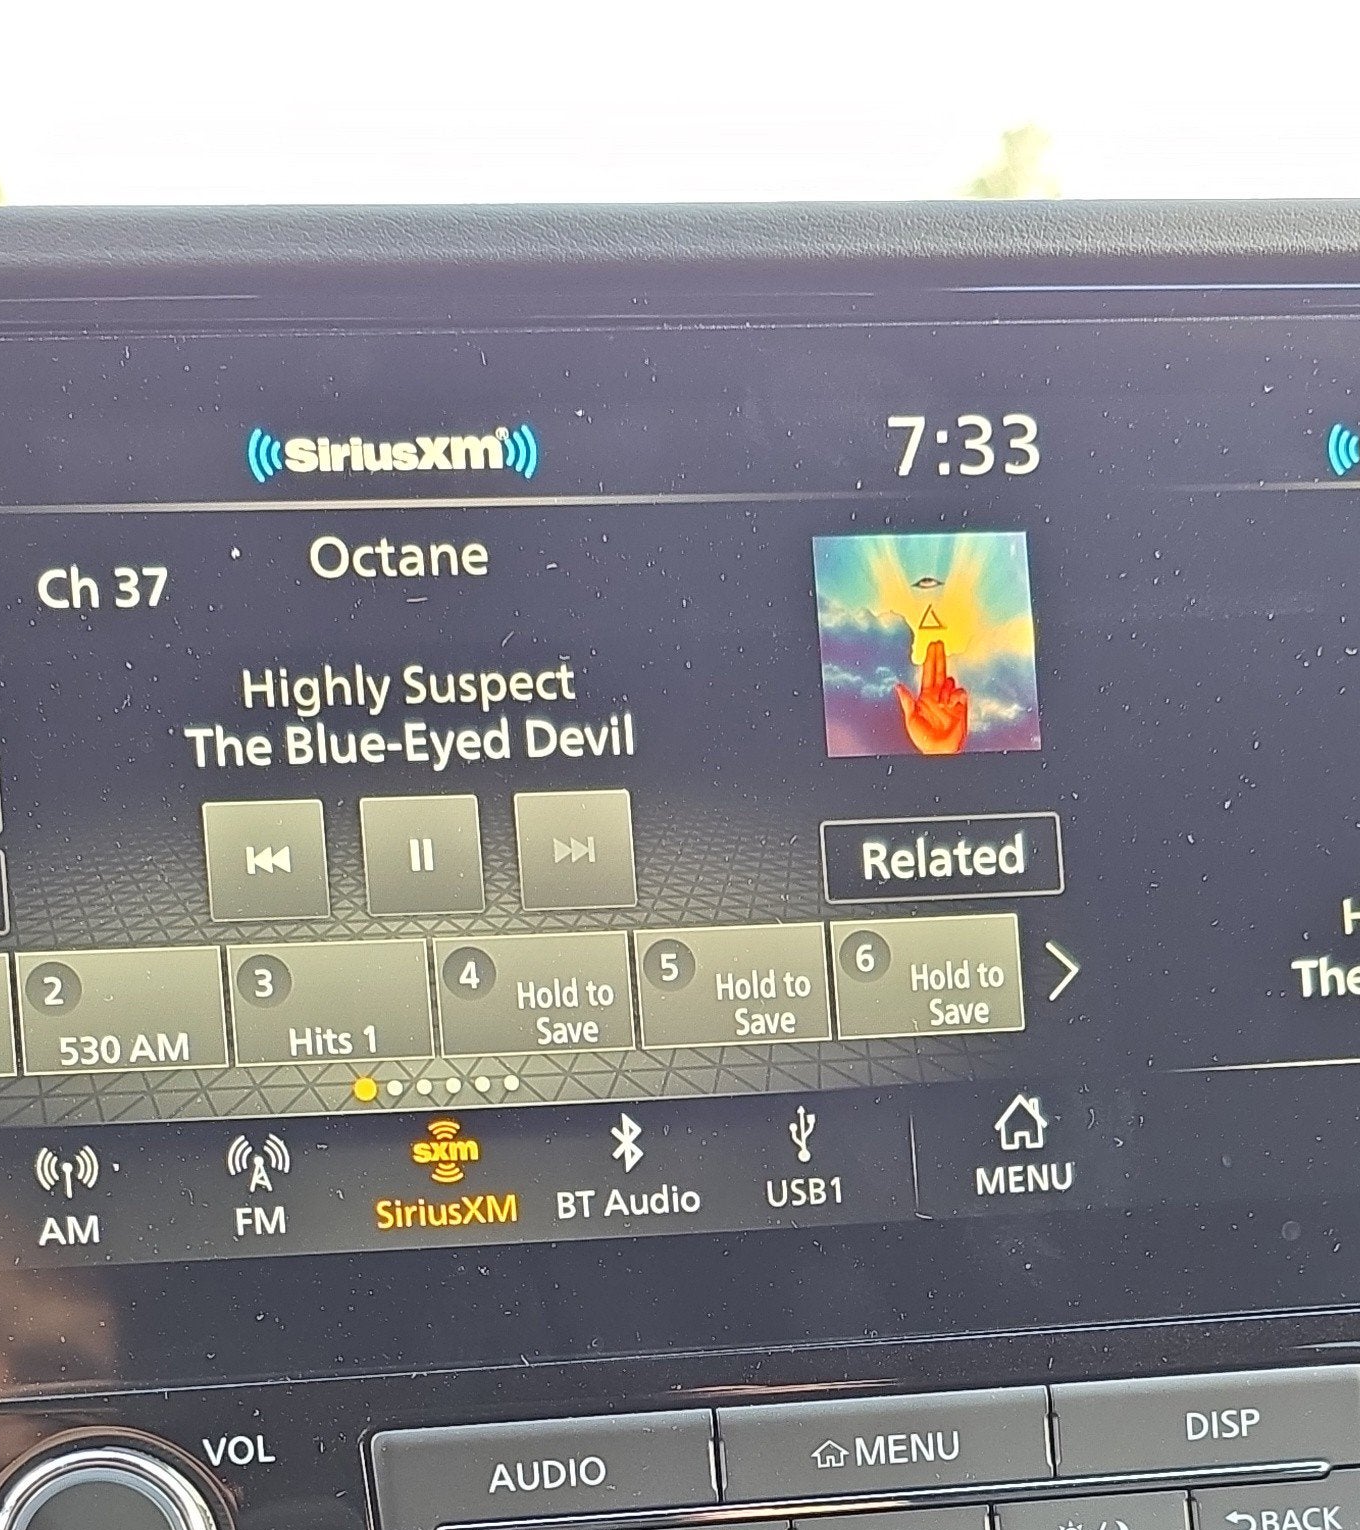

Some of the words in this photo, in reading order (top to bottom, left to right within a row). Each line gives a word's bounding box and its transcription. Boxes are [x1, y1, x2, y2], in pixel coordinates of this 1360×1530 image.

[888, 413, 1040, 476] 7:33
[310, 535, 488, 579] Octane
[38, 565, 100, 609] Ch
[115, 566, 169, 608] 37
[243, 664, 389, 717] Highly
[404, 664, 576, 712] Suspect
[184, 725, 272, 768] The
[287, 716, 510, 771] Blue-Eyed
[526, 713, 635, 758] Devil
[863, 832, 1025, 880] Related
[660, 953, 679, 982] 5
[855, 944, 875, 972] 6
[42, 977, 64, 1006] 2
[253, 969, 275, 998] 3
[458, 961, 480, 991] 4
[715, 969, 777, 1001] Hold
[784, 973, 811, 999] to
[910, 961, 971, 993] Hold
[979, 964, 1004, 990] to
[517, 979, 579, 1010] Hold
[587, 982, 615, 1008] to
[735, 1008, 796, 1037] Save
[929, 999, 990, 1027] Save
[289, 1028, 351, 1058] Hits
[363, 1026, 378, 1054] 1
[537, 1016, 599, 1045] Save
[59, 1036, 120, 1066] 530
[129, 1033, 190, 1063] AM
[413, 1140, 479, 1164] sxm
[766, 1175, 843, 1208] USB1
[976, 1162, 1075, 1196] MENU
[376, 1192, 517, 1230] SiriusXM
[556, 1189, 595, 1221] BT
[604, 1183, 701, 1218] Audio
[38, 1215, 100, 1247] AM
[236, 1205, 287, 1237] FM
[1185, 1408, 1260, 1441] DISP
[202, 1434, 276, 1467] VOL
[855, 1430, 960, 1467] MENU
[489, 1456, 607, 1494] AUDIO
